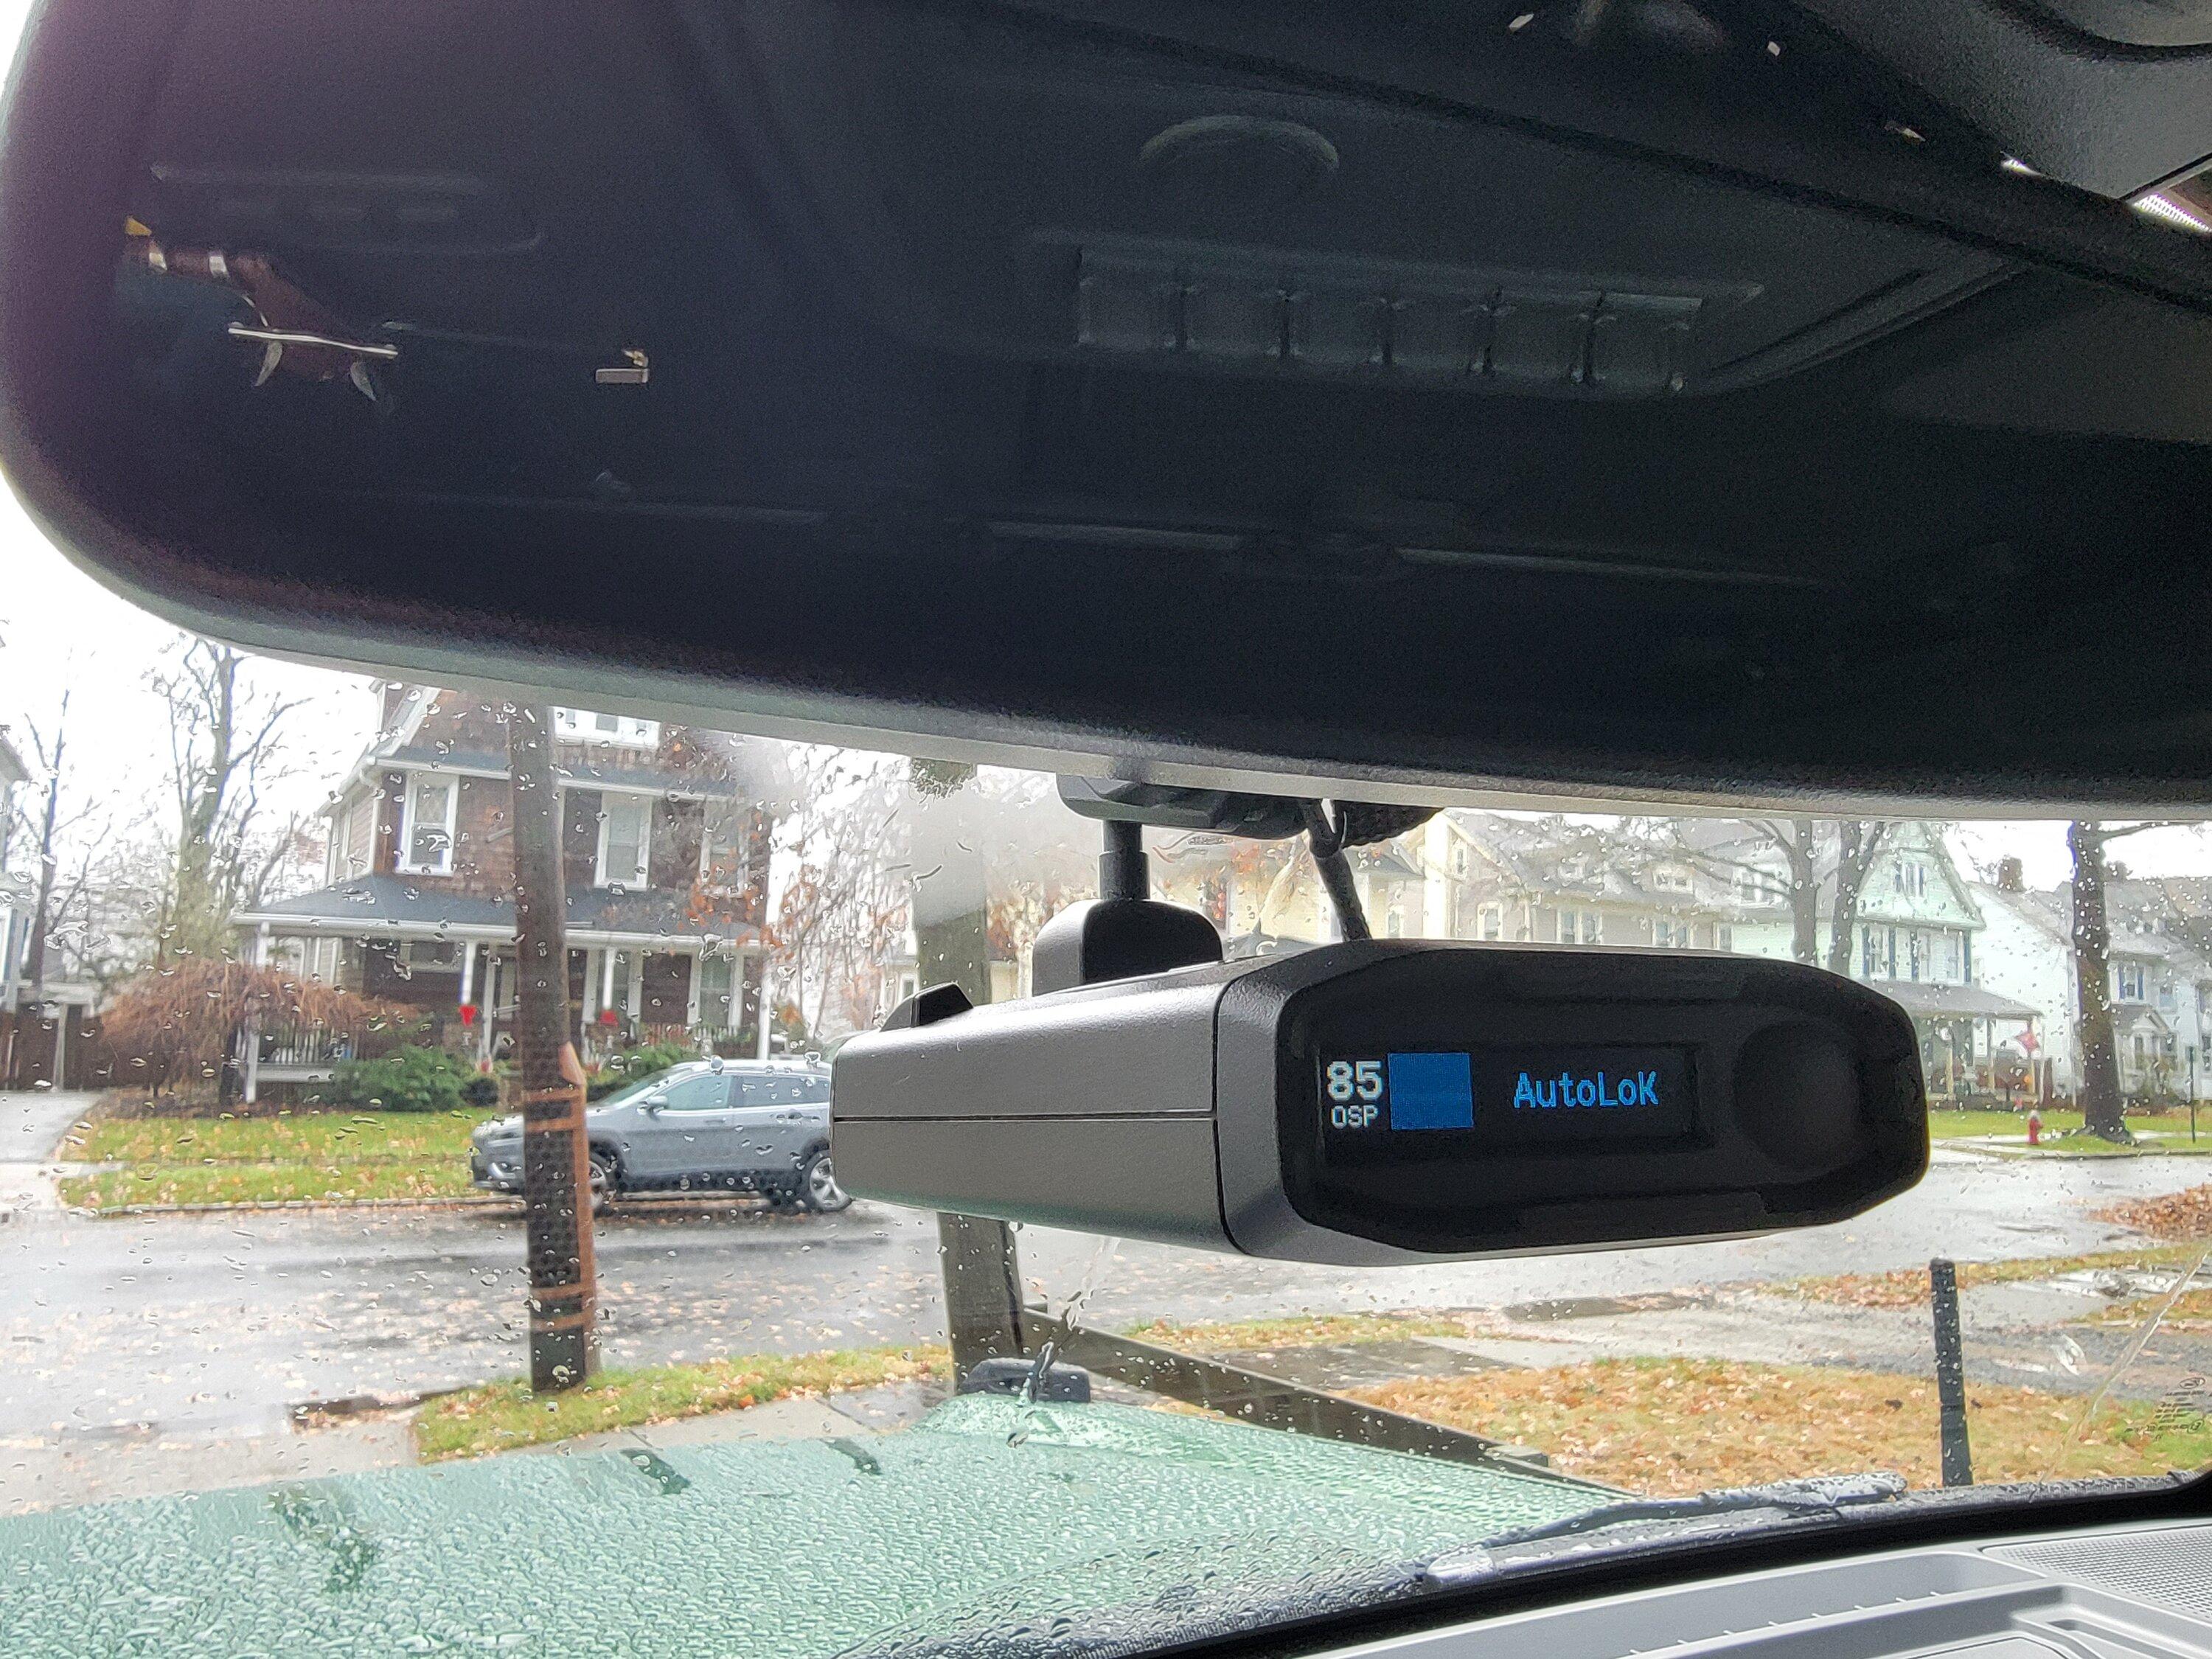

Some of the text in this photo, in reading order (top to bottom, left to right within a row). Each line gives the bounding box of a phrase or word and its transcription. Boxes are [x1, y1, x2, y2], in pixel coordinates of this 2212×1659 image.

[1326, 1060, 1384, 1101] 85
[1514, 1071, 1660, 1108] AutoLoK
[1330, 1105, 1380, 1128] OSP
